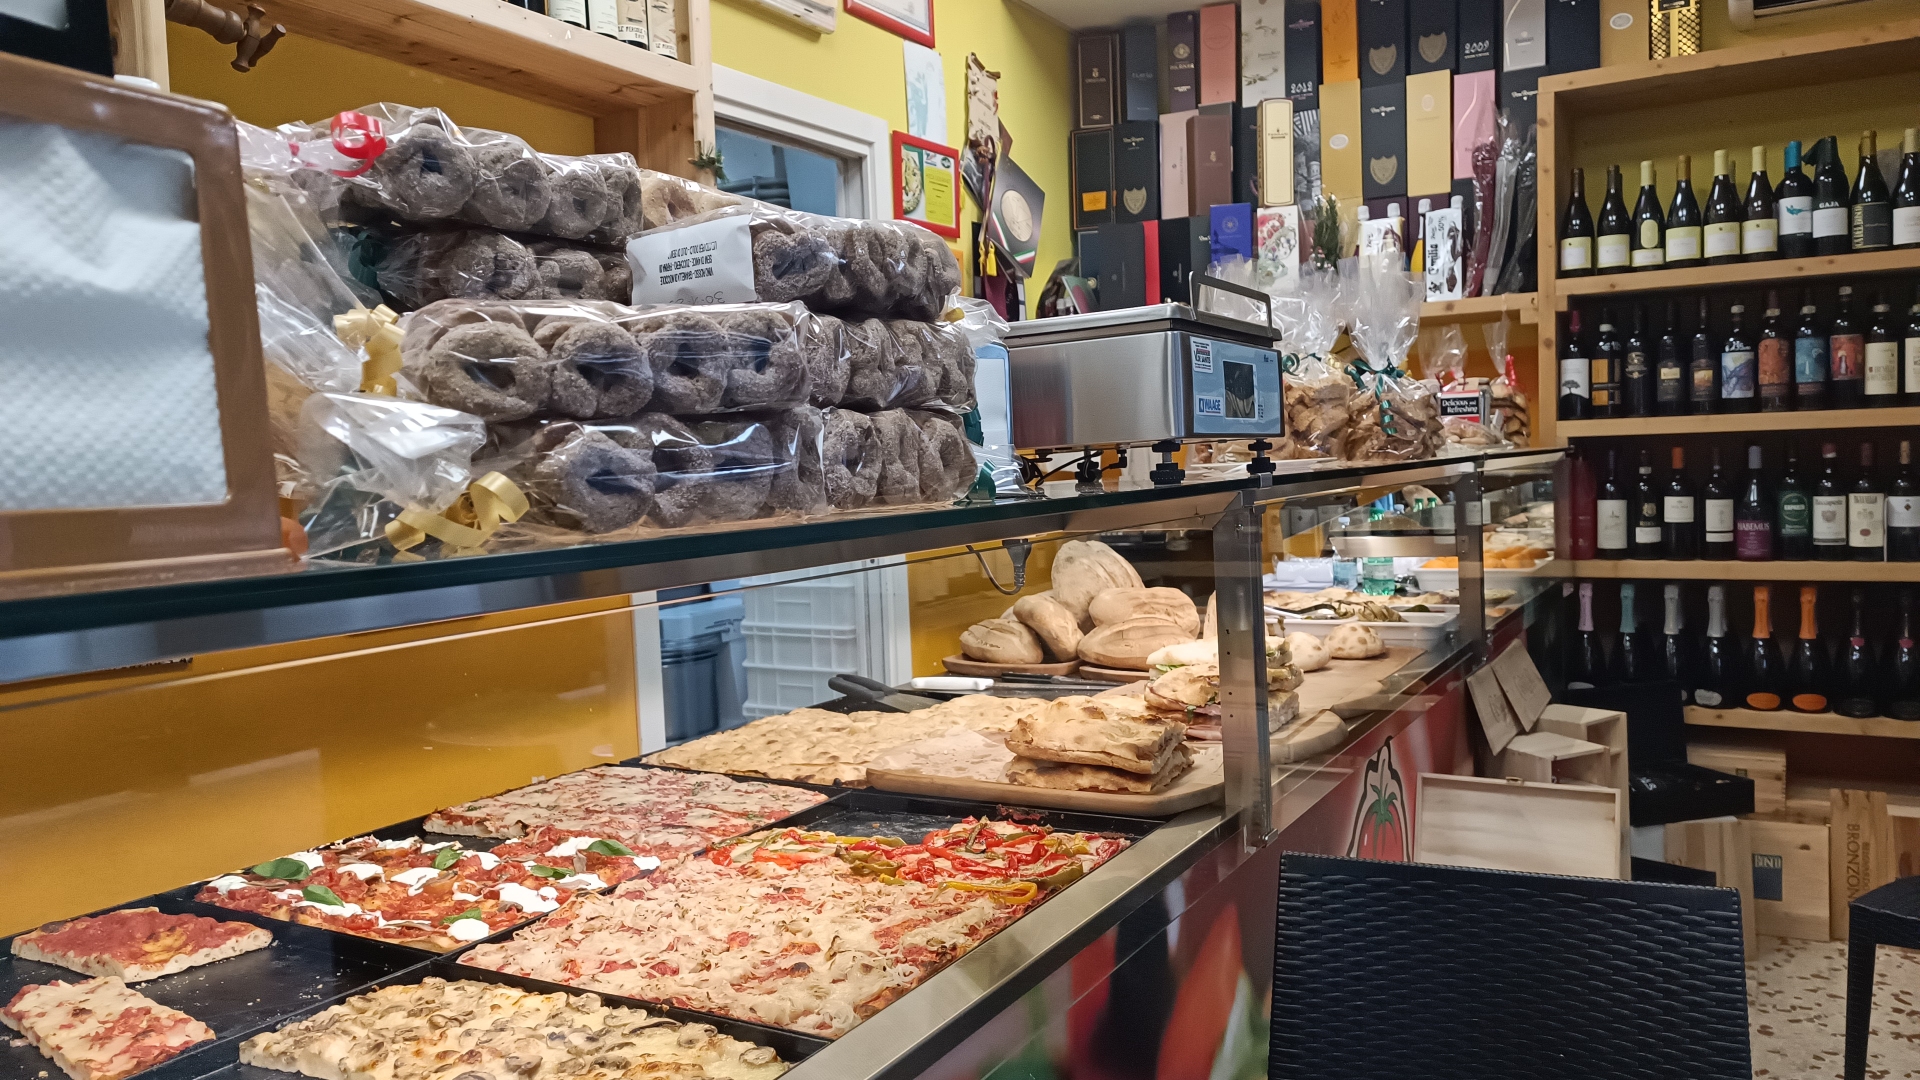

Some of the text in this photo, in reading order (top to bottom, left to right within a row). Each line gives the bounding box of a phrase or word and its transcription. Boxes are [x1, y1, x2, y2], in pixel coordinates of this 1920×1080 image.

[1819, 201, 1839, 209] GAJA
[1447, 405, 1477, 413] Refreshing
[1737, 522, 1770, 531] HABEMUS
